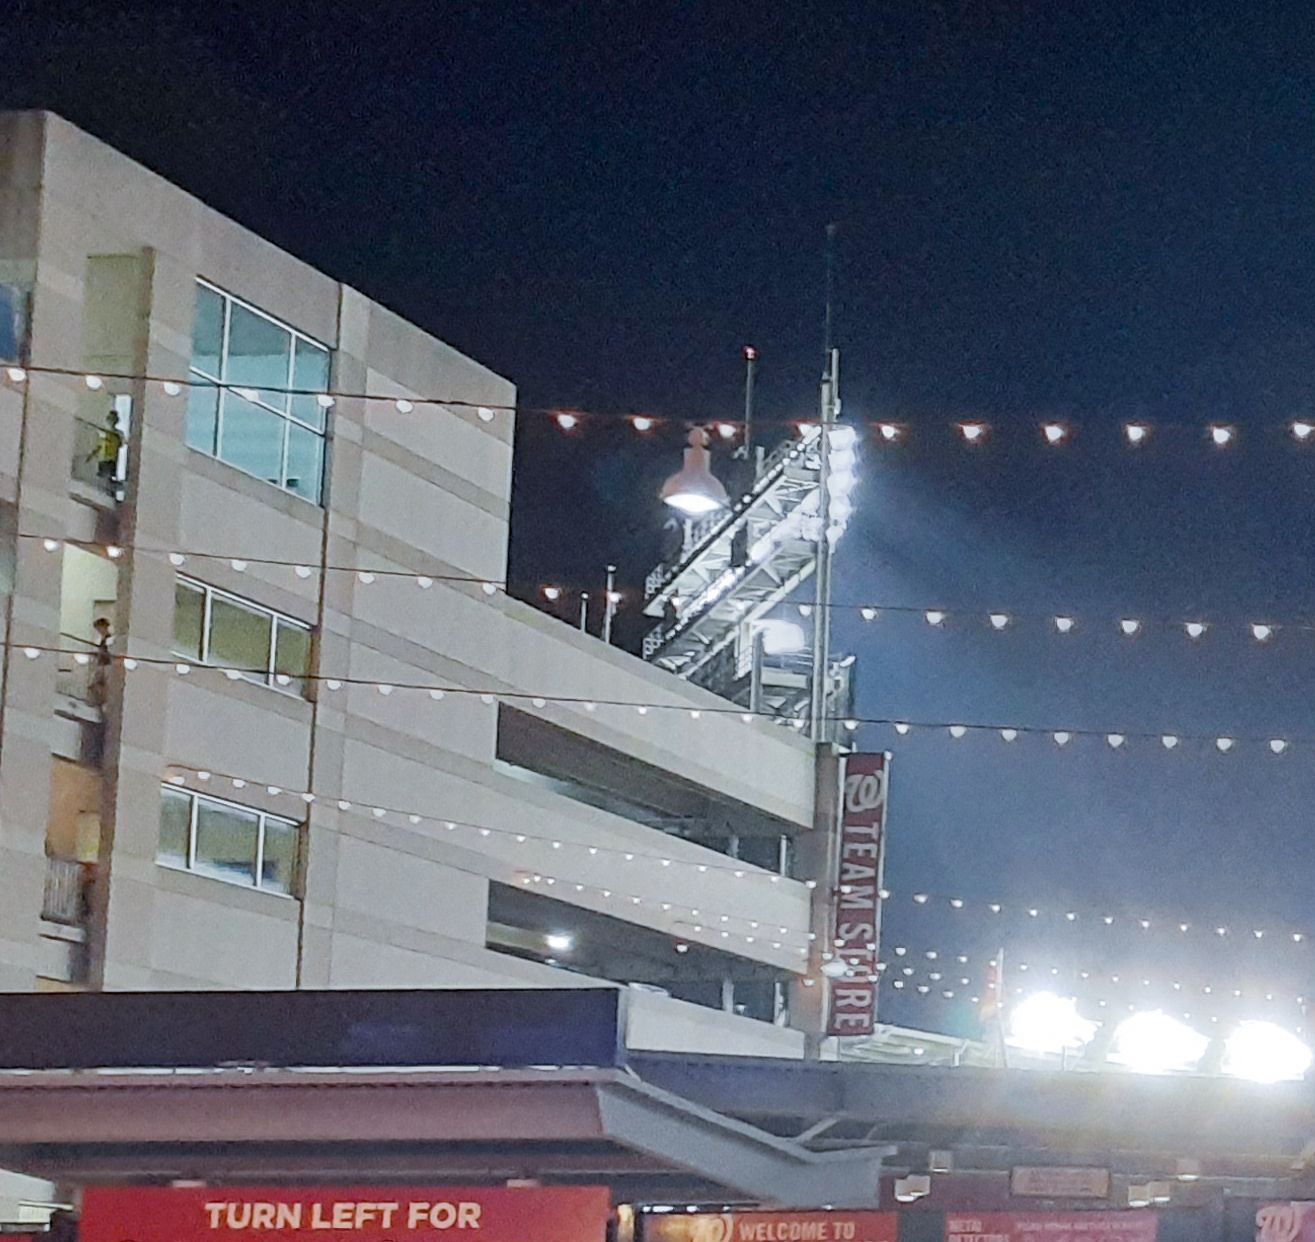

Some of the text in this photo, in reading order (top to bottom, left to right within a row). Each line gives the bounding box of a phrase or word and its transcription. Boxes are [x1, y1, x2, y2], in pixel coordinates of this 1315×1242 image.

[840, 821, 879, 910] TEAM
[205, 1201, 482, 1229] TURN LEFT FOR
[739, 1221, 856, 1241] WELCOME TO
